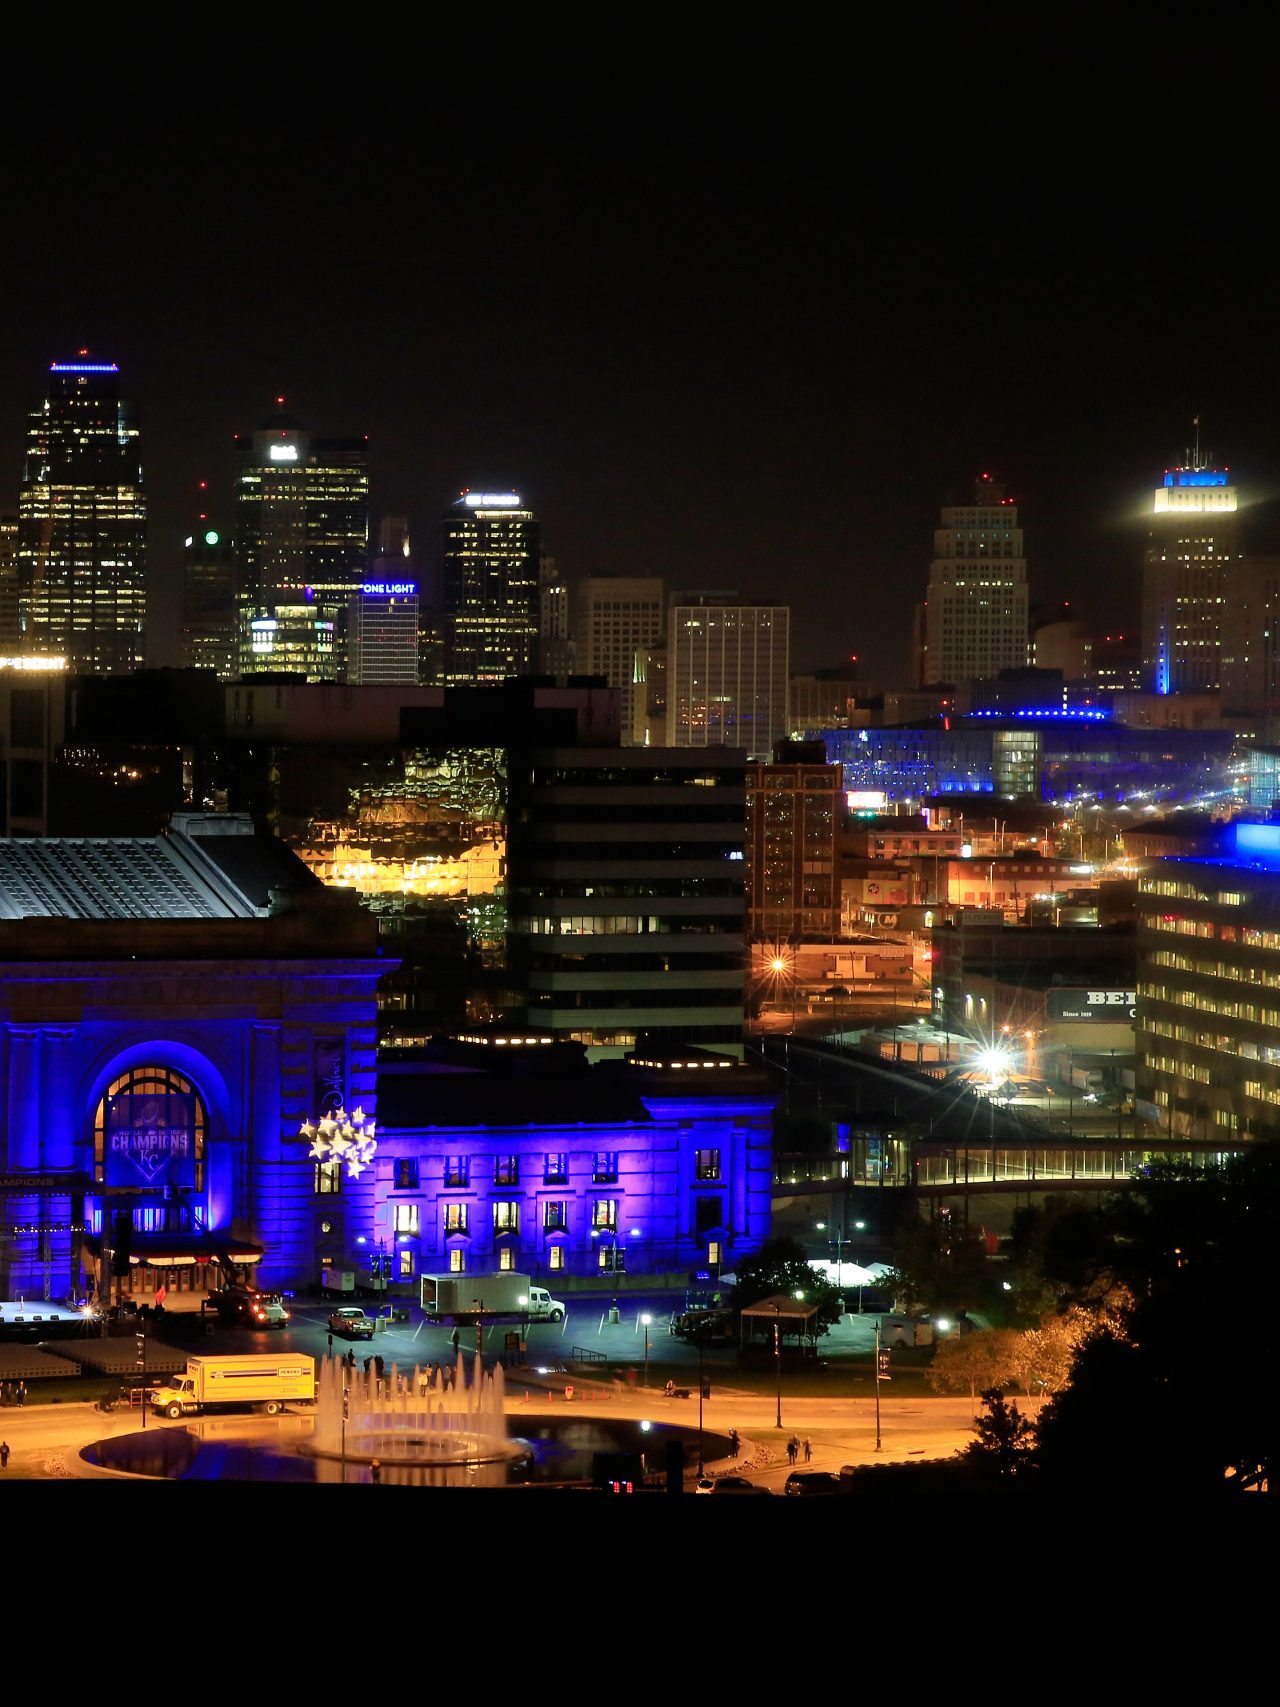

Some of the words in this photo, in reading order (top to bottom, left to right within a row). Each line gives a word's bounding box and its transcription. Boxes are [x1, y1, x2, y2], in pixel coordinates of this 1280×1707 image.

[363, 584, 384, 593] ONE
[386, 584, 415, 593] LIGHT
[111, 1135, 188, 1152] CHAMPIONS
